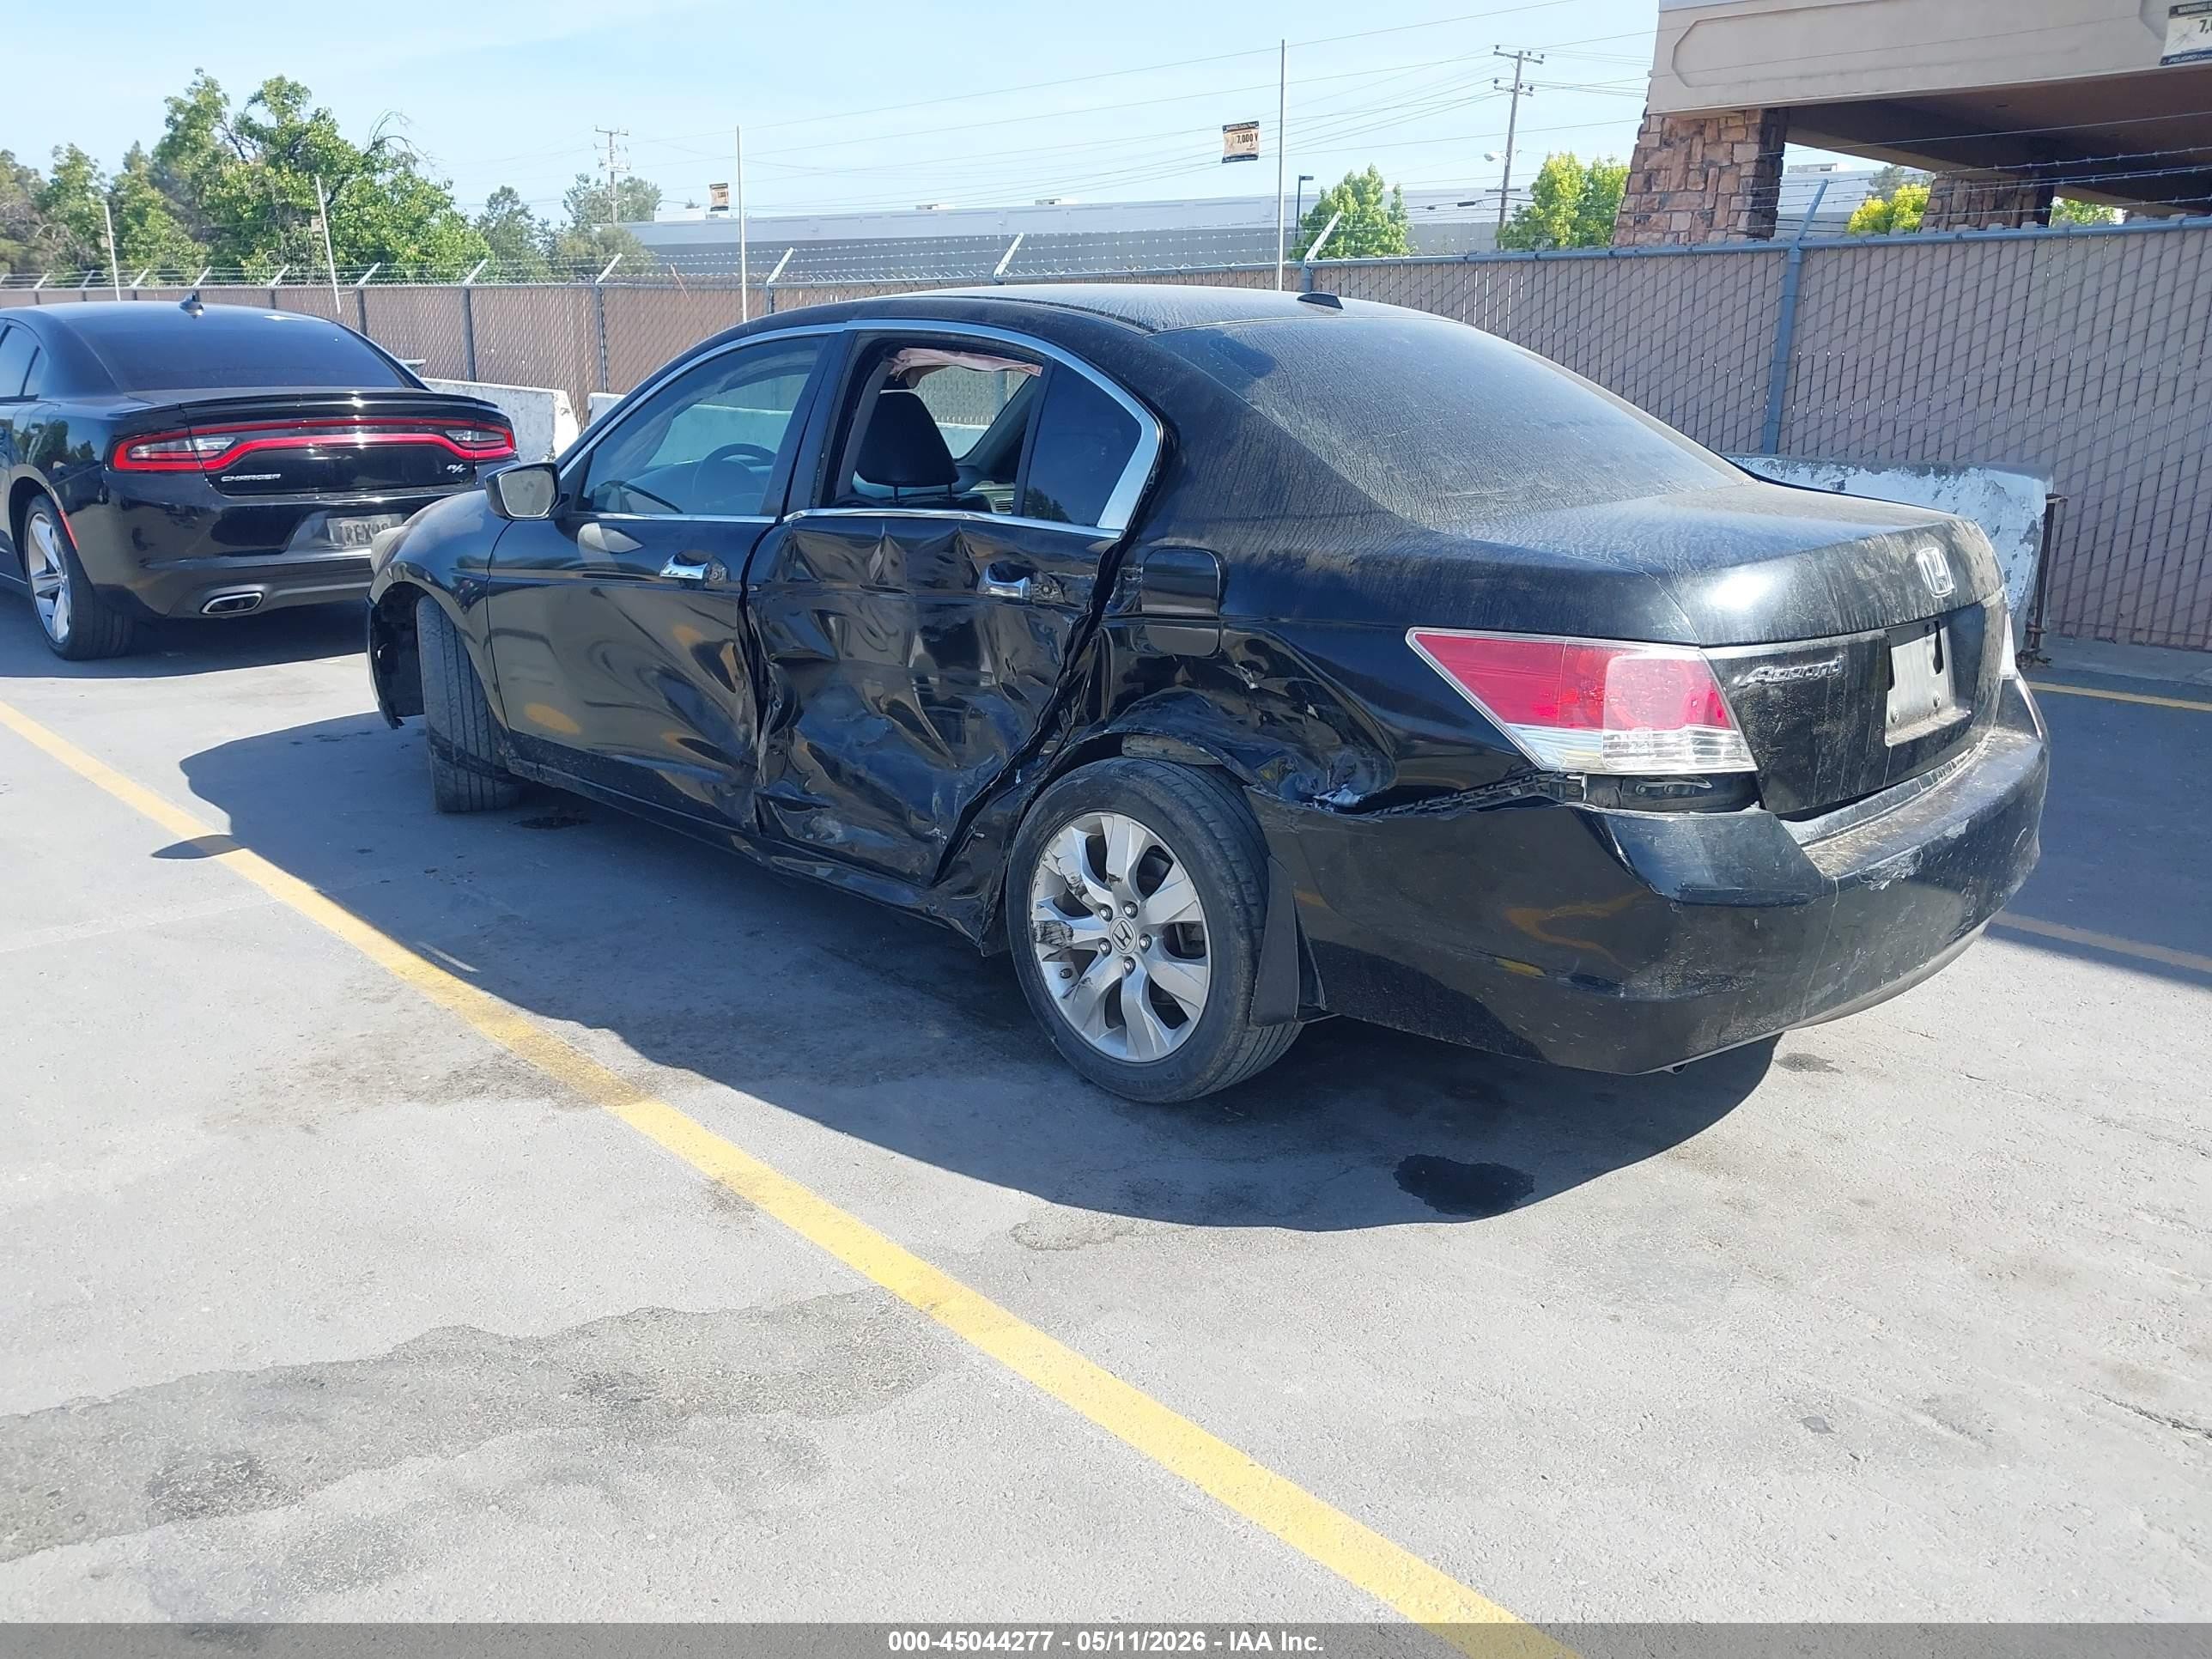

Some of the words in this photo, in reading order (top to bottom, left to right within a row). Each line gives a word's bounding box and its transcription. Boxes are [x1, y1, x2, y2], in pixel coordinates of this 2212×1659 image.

[1237, 134, 1253, 144] 7,000
[447, 464, 467, 473] R/T
[221, 473, 281, 482] CHARGER
[1735, 655, 1844, 688] Accord
